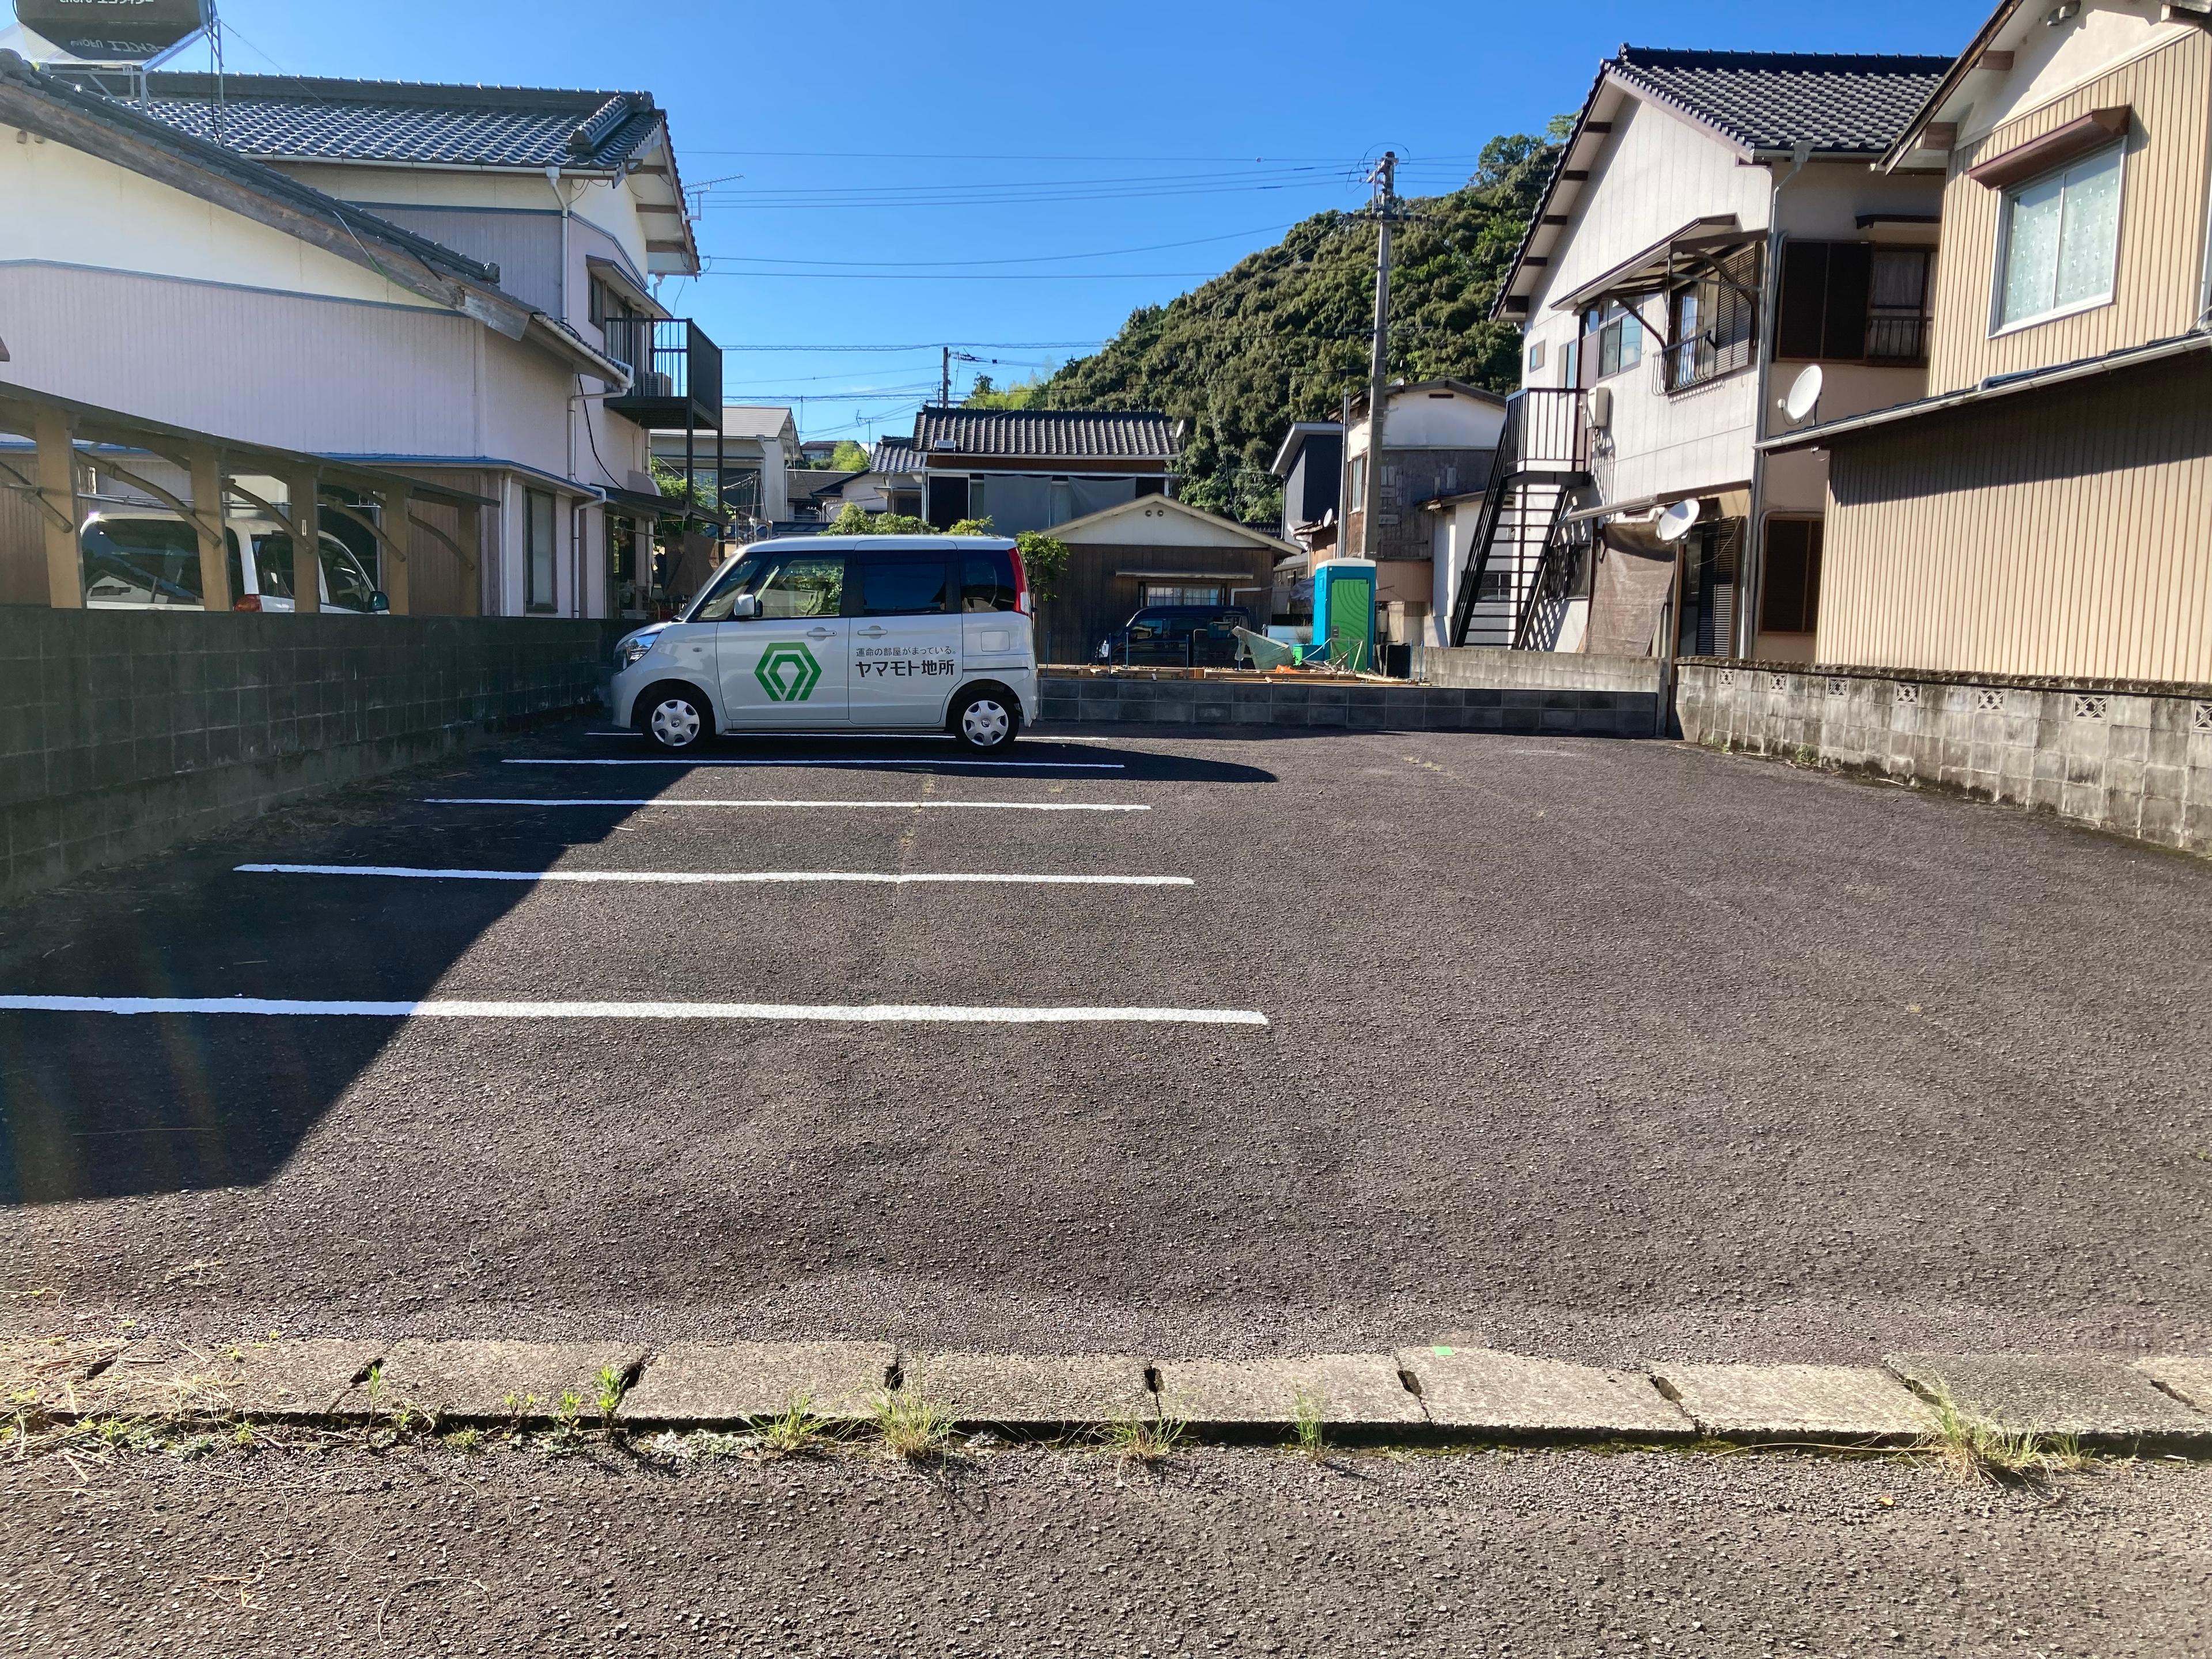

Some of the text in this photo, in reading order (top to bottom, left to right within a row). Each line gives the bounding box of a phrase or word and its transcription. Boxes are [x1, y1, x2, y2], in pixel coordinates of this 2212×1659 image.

[856, 646, 956, 657] 運命の部屋がまっている。
[855, 659, 955, 677] ヤマモト地所
